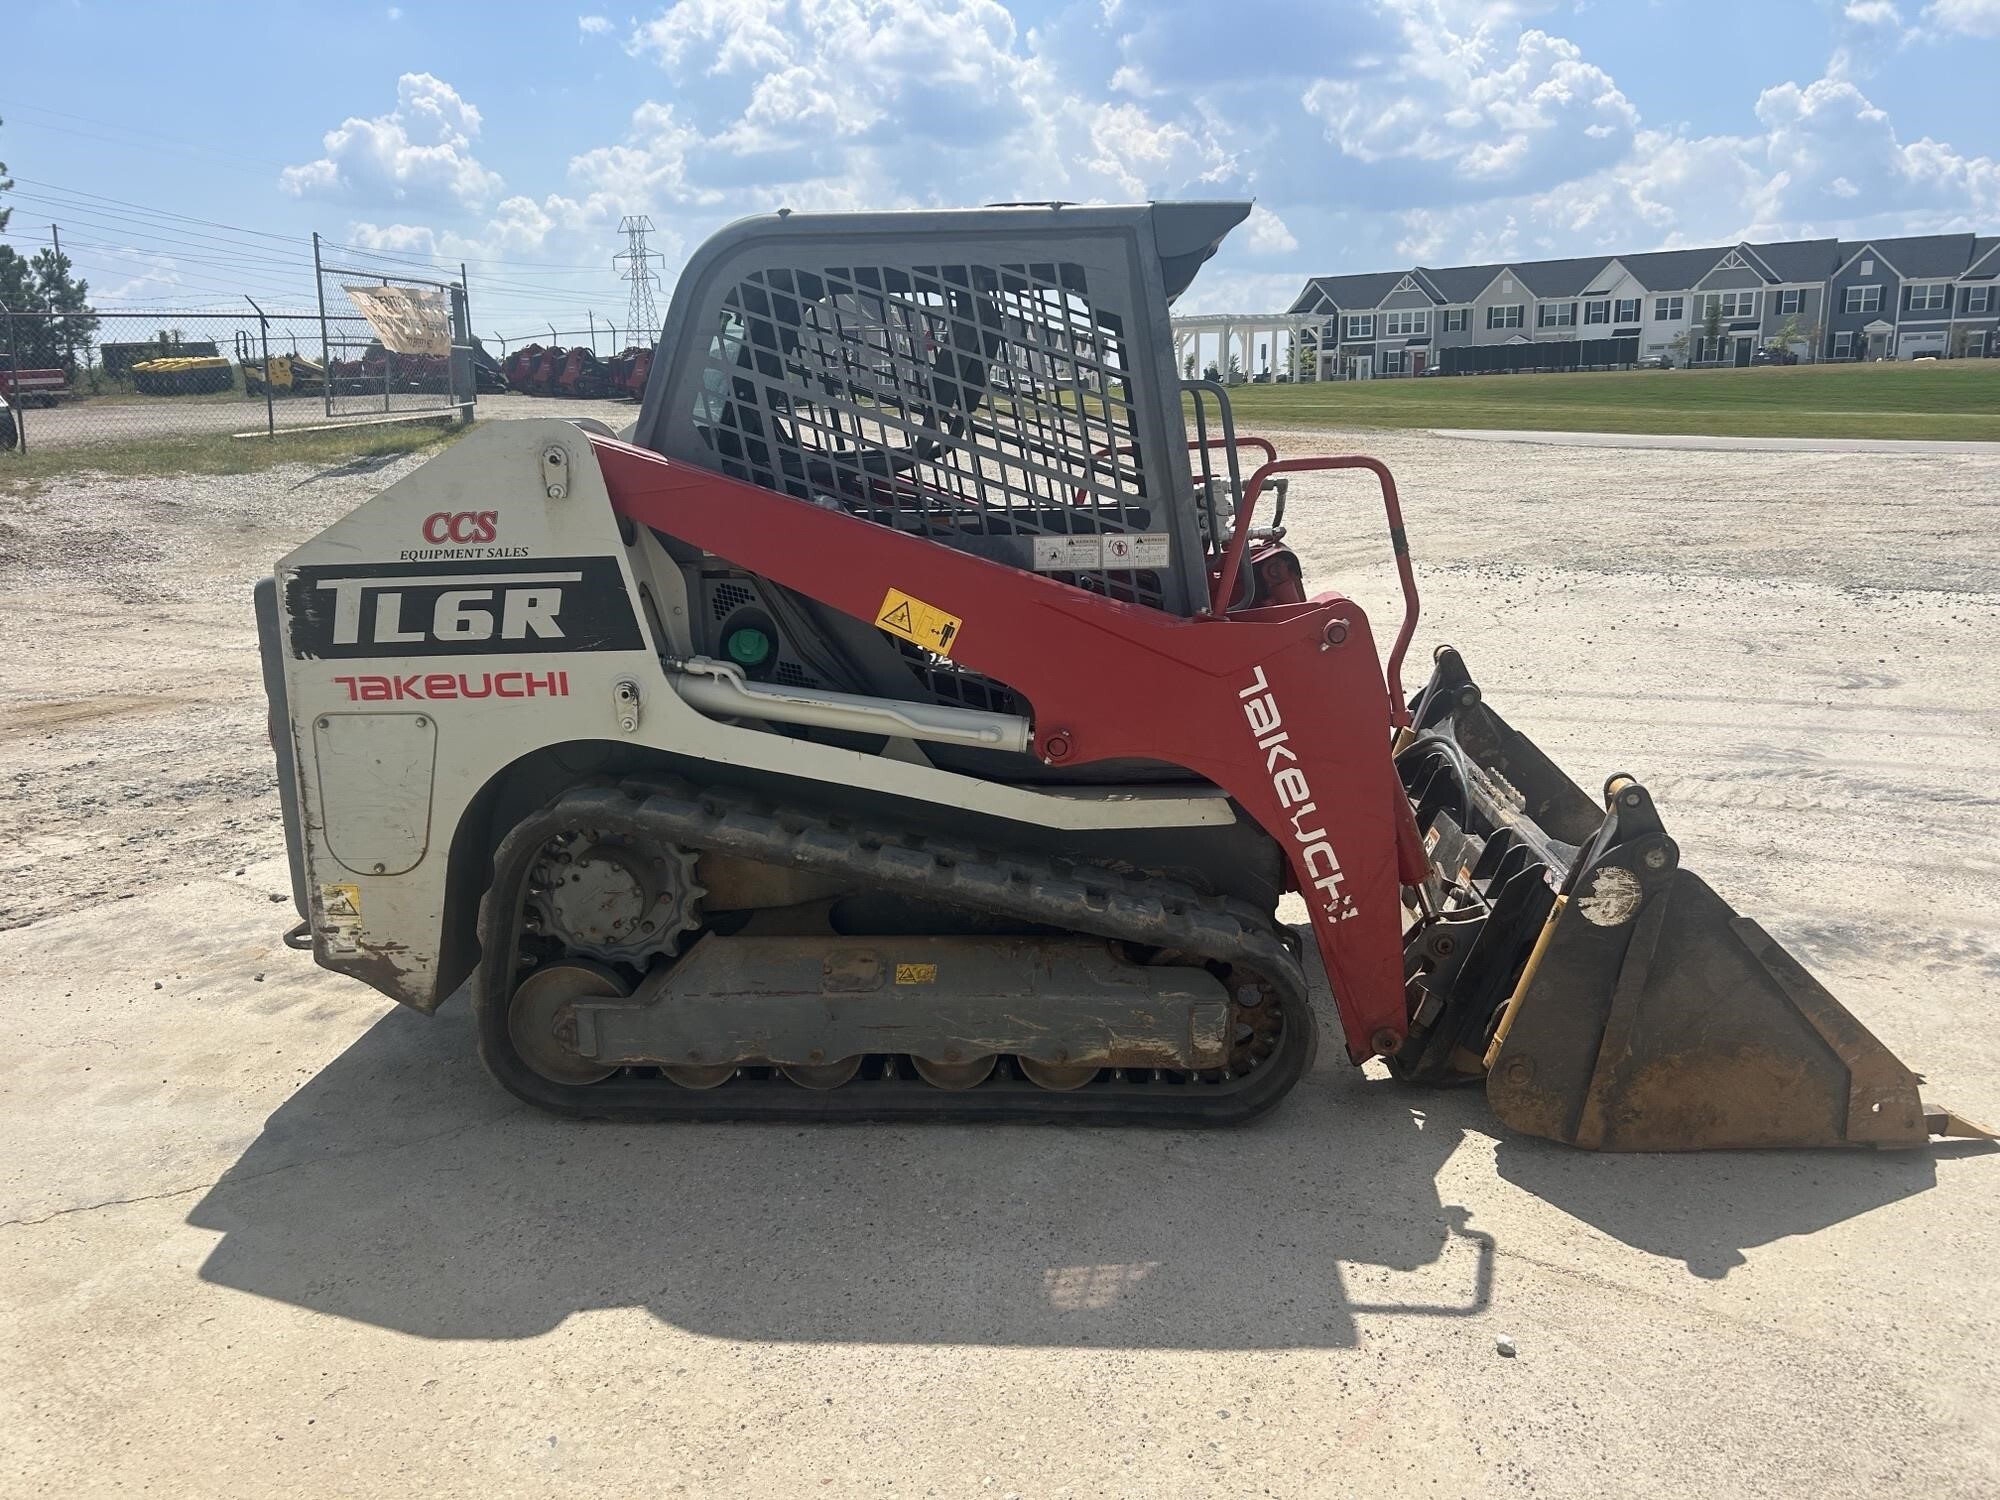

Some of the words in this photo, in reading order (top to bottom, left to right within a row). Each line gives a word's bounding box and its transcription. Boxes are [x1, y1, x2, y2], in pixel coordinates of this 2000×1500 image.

[422, 510, 498, 545] CCS
[400, 548, 484, 563] EQUIPMENT
[486, 546, 529, 558] SALES
[316, 571, 582, 644] TL6R
